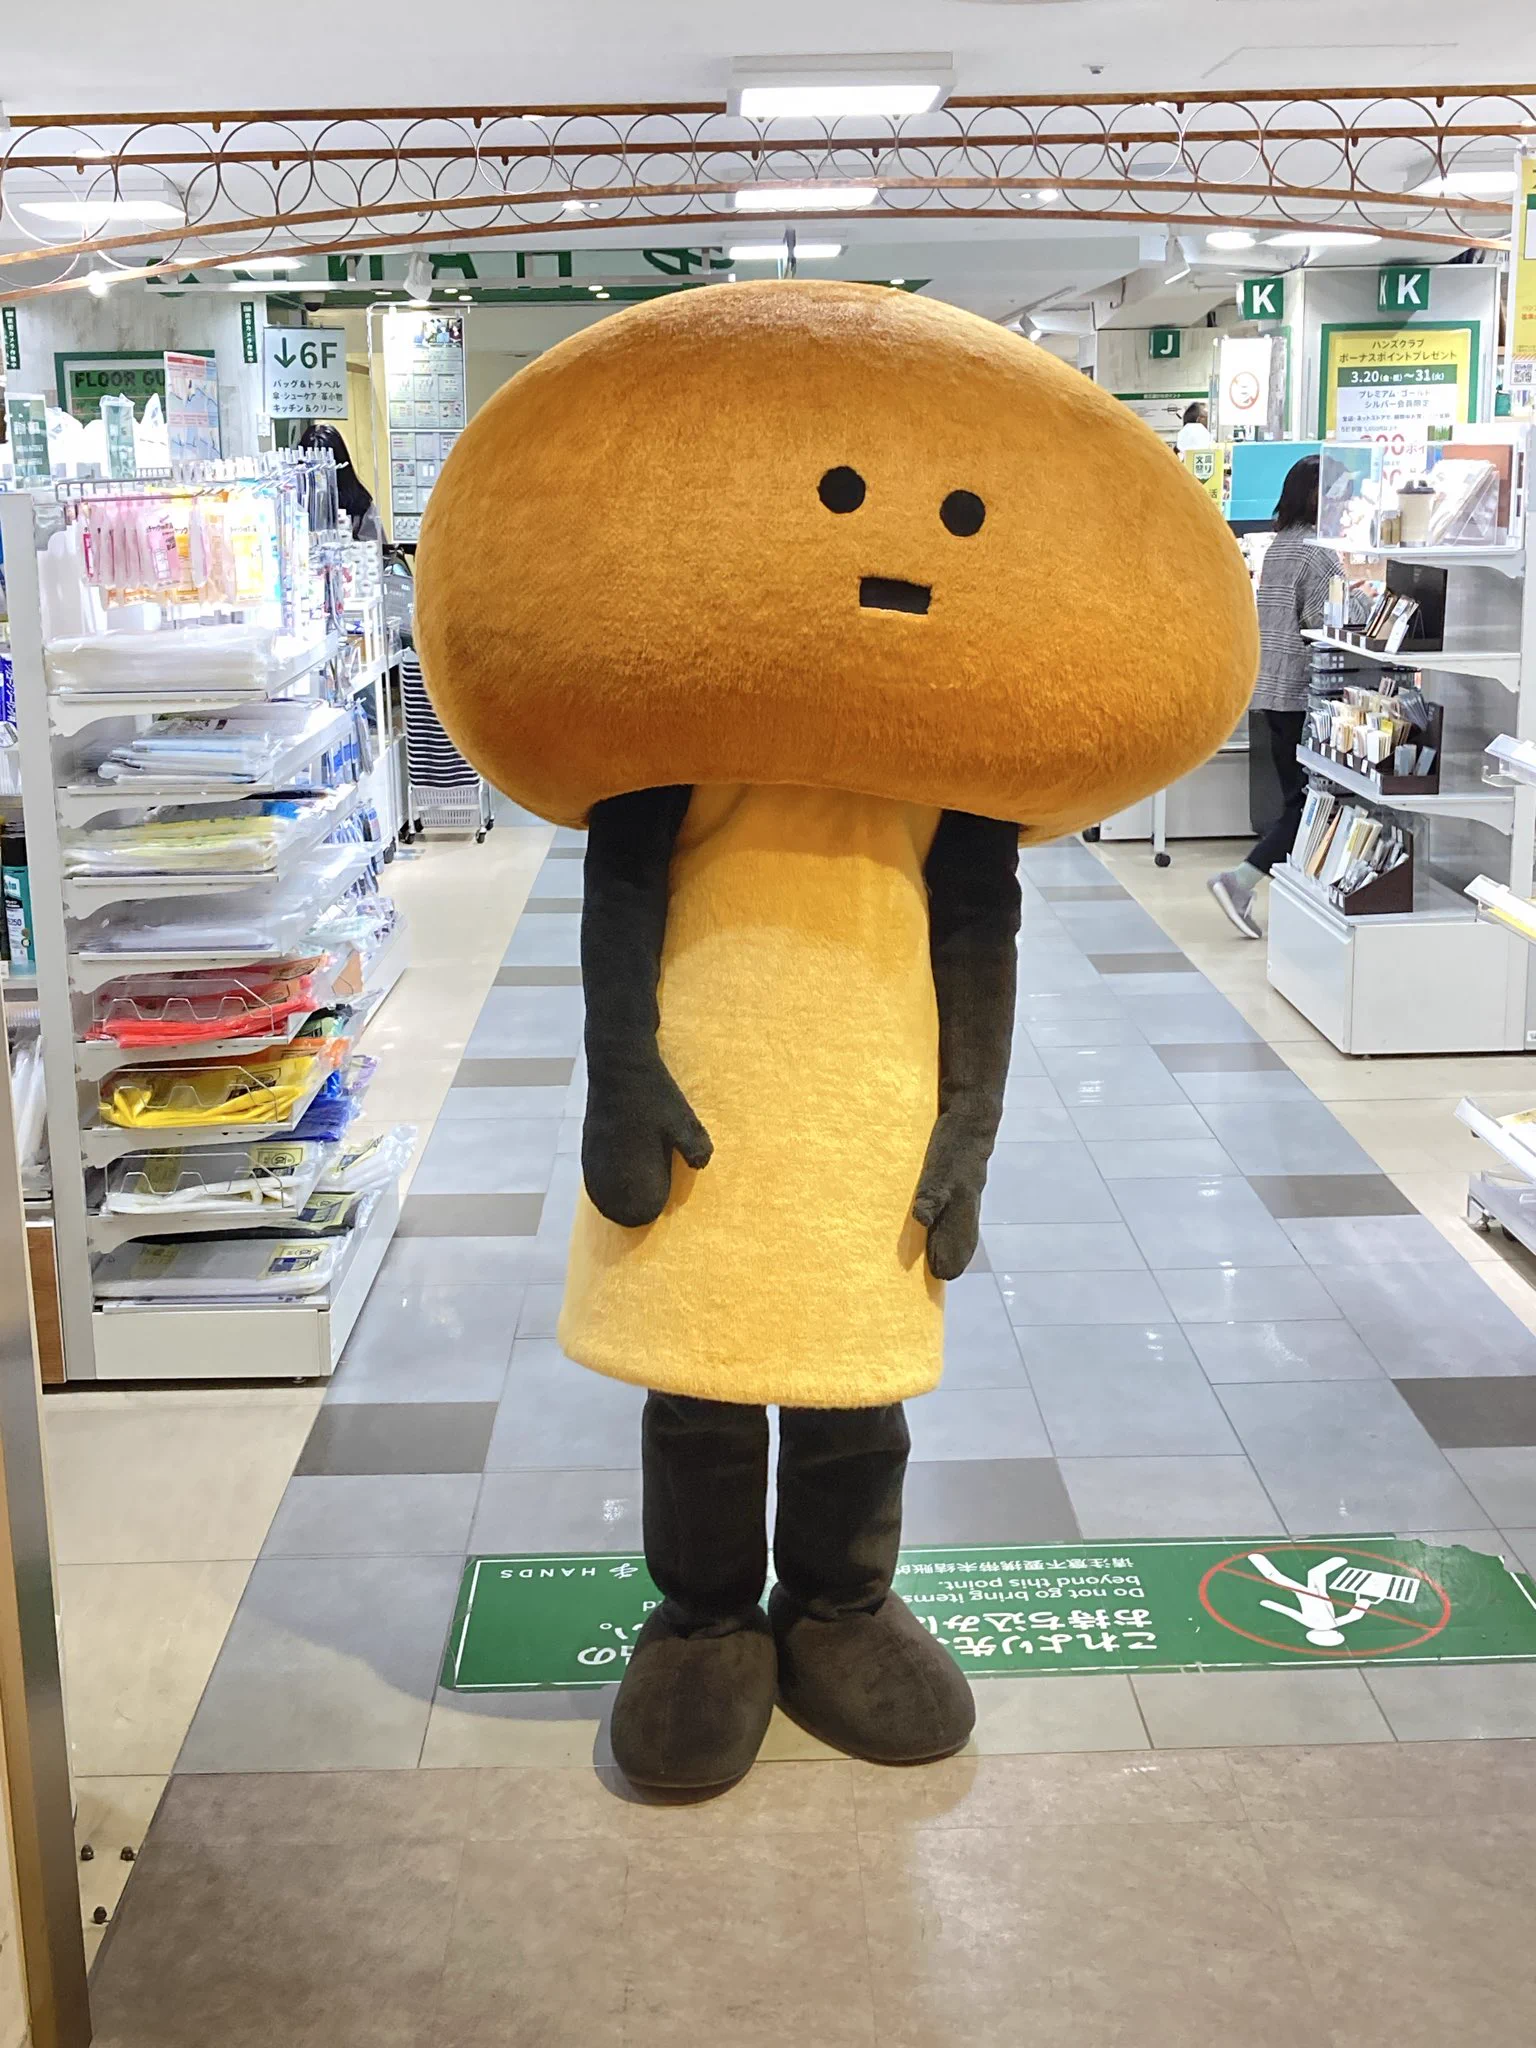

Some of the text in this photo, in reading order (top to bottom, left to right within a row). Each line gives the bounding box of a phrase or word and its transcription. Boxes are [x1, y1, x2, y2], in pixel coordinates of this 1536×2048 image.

[1252, 284, 1275, 313] K
[1397, 274, 1421, 304] K
[1160, 335, 1173, 354] J
[1372, 339, 1425, 349] ハンズクラブ
[300, 341, 338, 369] 6F
[75, 371, 136, 387] FLOOR
[500, 1566, 596, 1579] HANDS
[938, 1573, 1141, 1591] beyond this point.
[902, 1586, 1145, 1605] Do not go bring items
